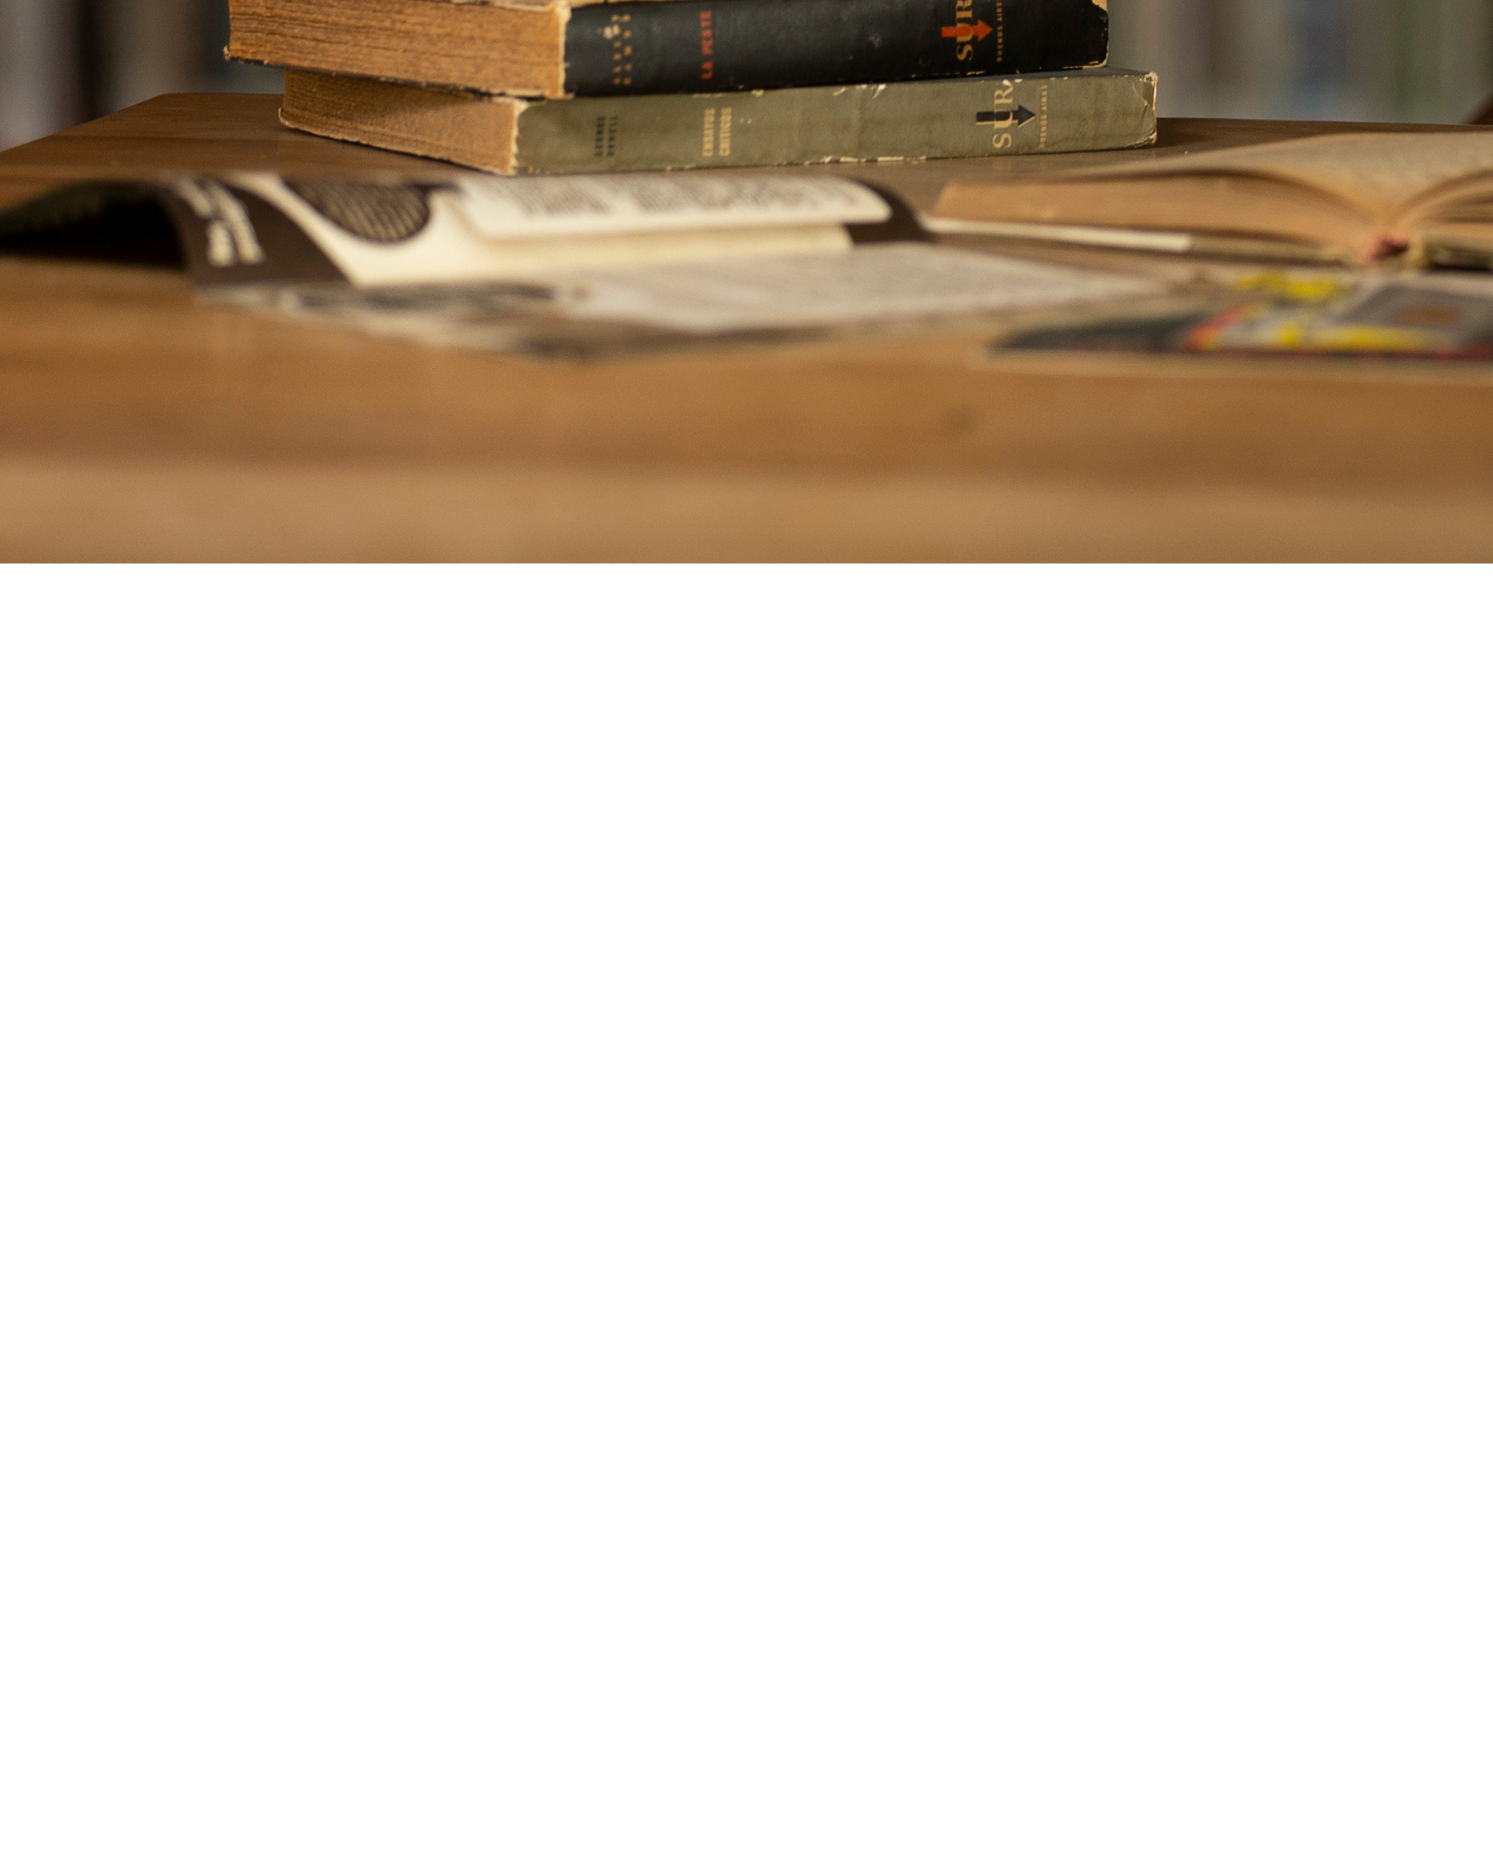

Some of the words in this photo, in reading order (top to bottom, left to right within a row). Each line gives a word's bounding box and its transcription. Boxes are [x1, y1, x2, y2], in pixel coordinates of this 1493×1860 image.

[700, 9, 714, 56] PESTE
[701, 61, 714, 80] LA
[992, 83, 1014, 149] SUR
